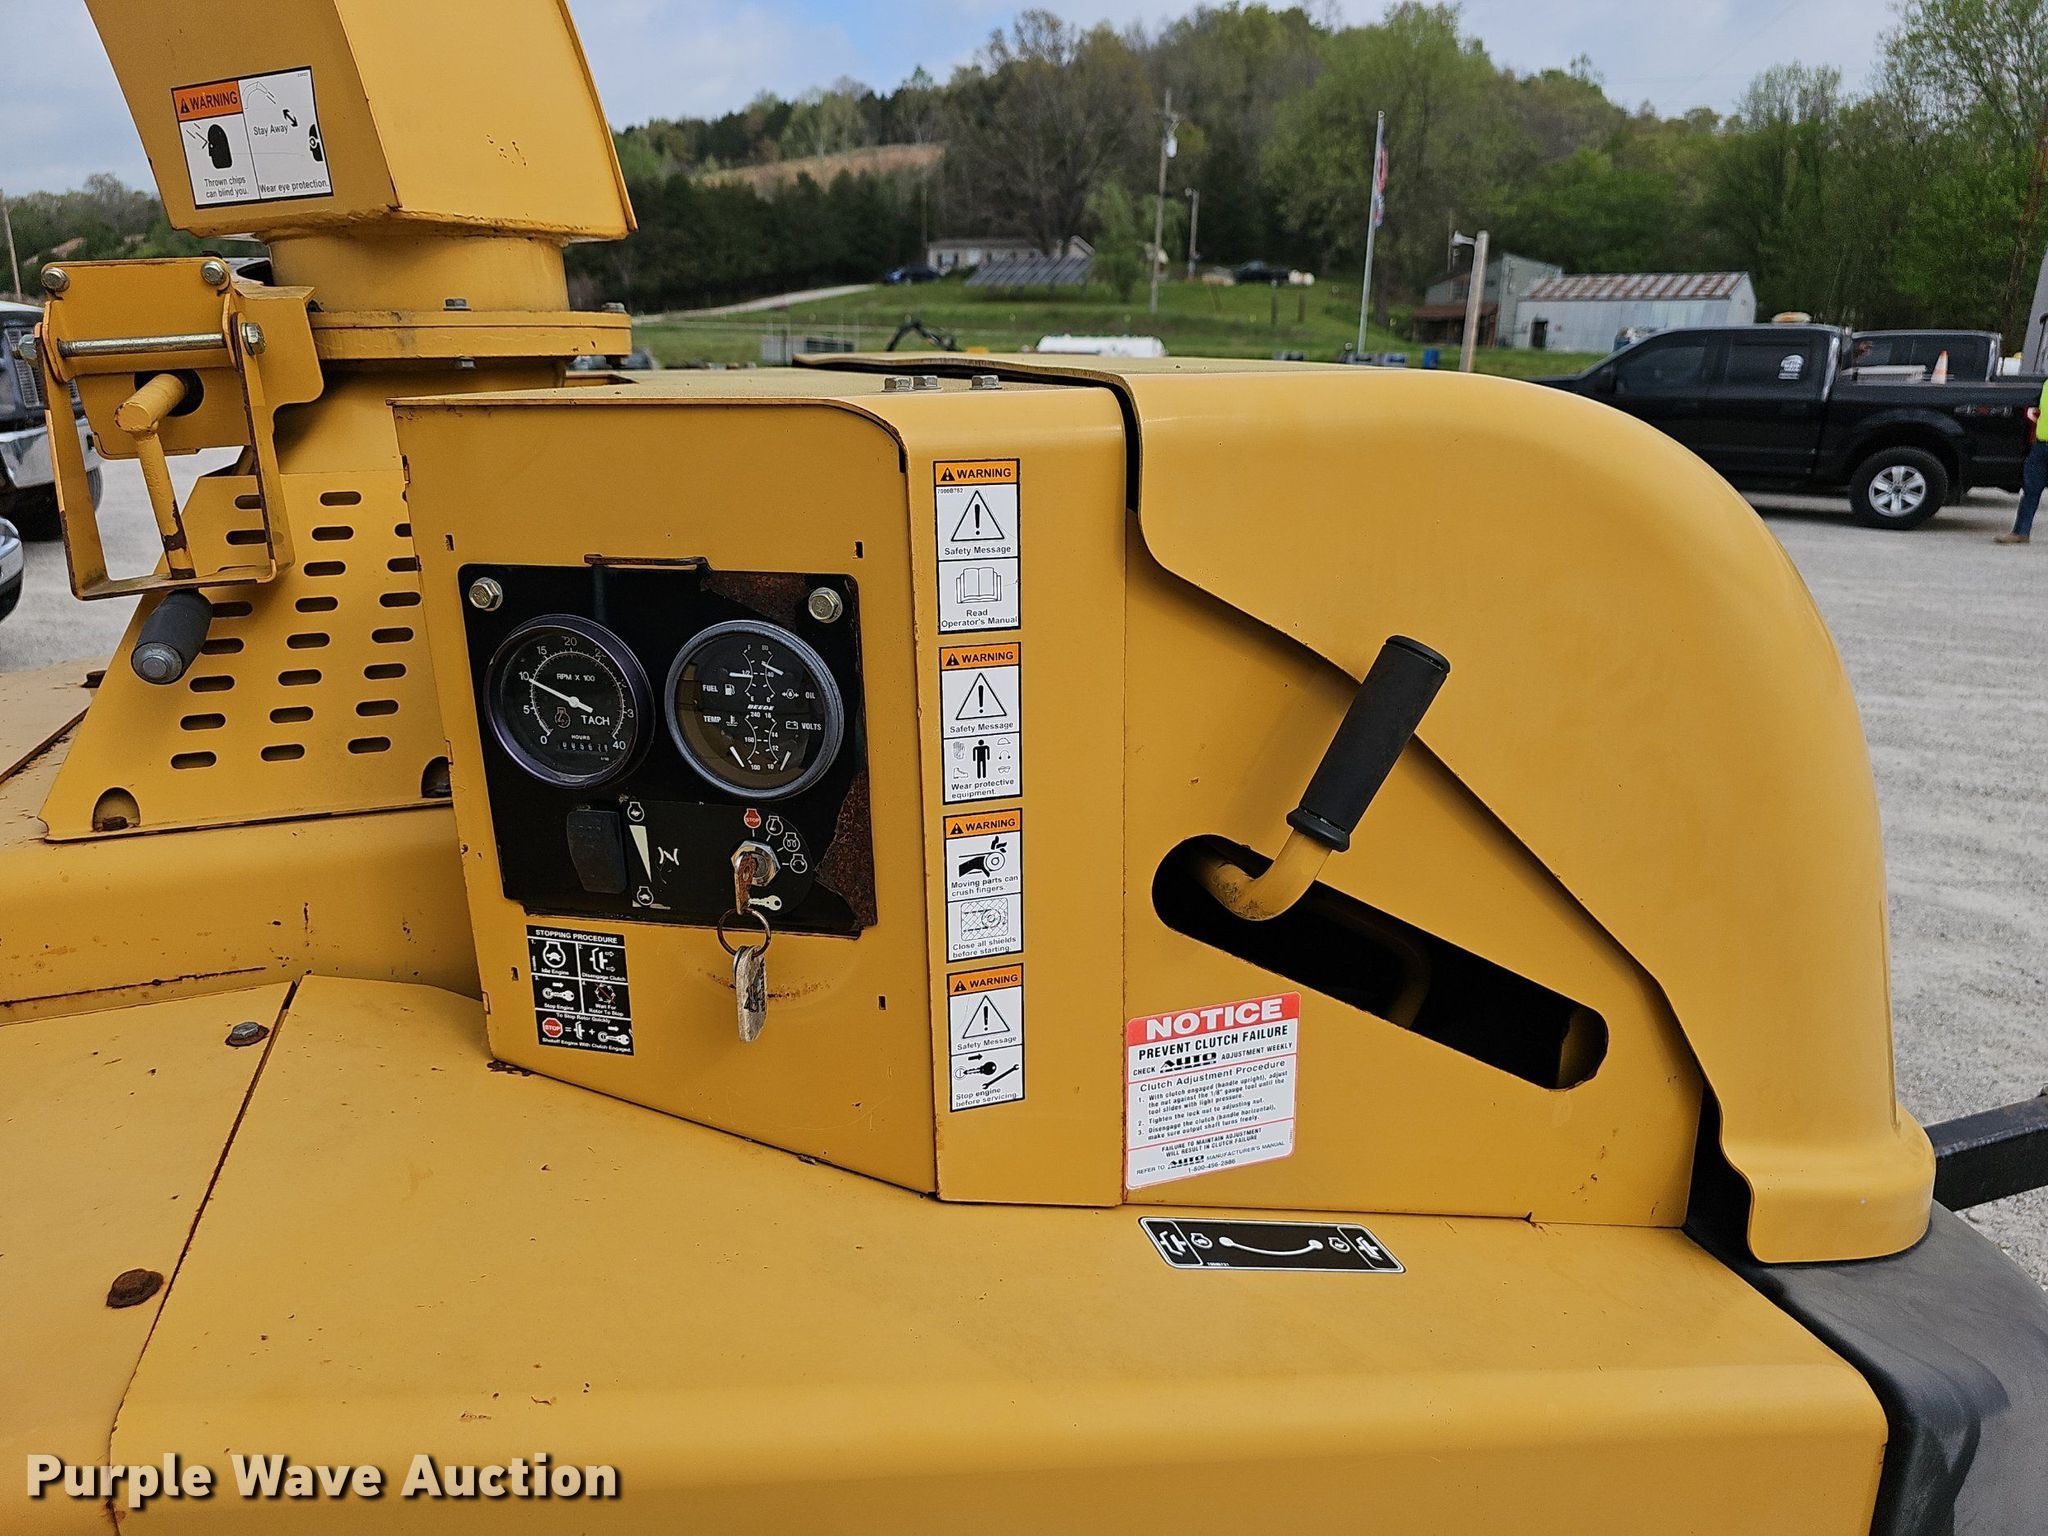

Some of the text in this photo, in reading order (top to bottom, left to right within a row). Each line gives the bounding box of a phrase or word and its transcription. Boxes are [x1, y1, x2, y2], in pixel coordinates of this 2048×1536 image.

[190, 92, 238, 110] WARNING
[254, 124, 288, 136] Stay Away
[204, 176, 246, 188] Thrown chips
[218, 188, 234, 197] blind
[260, 184, 276, 193] Wear
[278, 184, 290, 192] eye
[957, 468, 1012, 479] WARNING
[944, 546, 1011, 556] Safety Message
[966, 609, 988, 617] Read
[942, 616, 1018, 628] Operator's Manual
[564, 637, 578, 647] 20
[537, 646, 547, 655] 15
[962, 652, 1014, 663] WARNING
[519, 672, 530, 681] 10
[556, 673, 572, 681] RPM
[702, 684, 718, 692] FUEL
[524, 706, 530, 715] 5
[581, 715, 610, 726] TACH
[802, 723, 822, 731] VOLTS
[950, 722, 1014, 734] Safety Message
[613, 740, 626, 750] 40
[952, 778, 1015, 791] Wear protective
[966, 818, 1016, 831] WARNING
[952, 880, 981, 889] Moving
[982, 877, 1003, 886] parts
[952, 885, 1006, 897] crush fingers.
[536, 930, 618, 944] STOPPING PROCEDURE
[953, 942, 975, 950] Close
[988, 936, 1017, 946] shields
[953, 950, 978, 959] before
[970, 974, 1018, 988] WARNING
[1147, 998, 1282, 1040] NOTICE
[958, 1036, 1017, 1051] Safety Message
[1139, 1025, 1288, 1060] PREVENT CLUTCH FAILURE
[1133, 1066, 1156, 1076] CHECK
[1222, 1047, 1265, 1060] ADJUSTMENT
[1267, 1042, 1293, 1052] WEEKLY
[1140, 1060, 1285, 1092] Clutch Adjustment Procedure
[1166, 1088, 1185, 1097] clutch
[1188, 1084, 1214, 1094] engaged
[1269, 1070, 1288, 1079] adjust
[956, 1088, 1001, 1100] Stop engine
[1173, 1094, 1197, 1104] against
[1224, 1087, 1243, 1095] gauge
[1258, 1080, 1273, 1088] until
[956, 1098, 981, 1107] before
[1163, 1104, 1182, 1113] slides
[1184, 1101, 1198, 1109] with
[1199, 1098, 1214, 1106] light
[1149, 1115, 1173, 1124] Tighten
[1222, 1101, 1251, 1110] adjusting
[1149, 1123, 1181, 1133] Disengage
[1195, 1116, 1215, 1125] clutch
[1182, 1125, 1203, 1134] output
[1204, 1121, 1220, 1130] shaft
[1222, 1118, 1238, 1126] turns
[1162, 1144, 1185, 1152] FAILURE
[1196, 1136, 1224, 1145] MAINTAIN
[1226, 1128, 1262, 1139] ADJUSTMENT
[1181, 1146, 1202, 1154] RESULT
[1212, 1140, 1233, 1148] CLUTCH
[1234, 1135, 1257, 1144] FAILURE
[1136, 1167, 1156, 1175] REFER
[1206, 1145, 1261, 1160] MANUFACTURER'S
[1262, 1140, 1285, 1149] MANUAL
